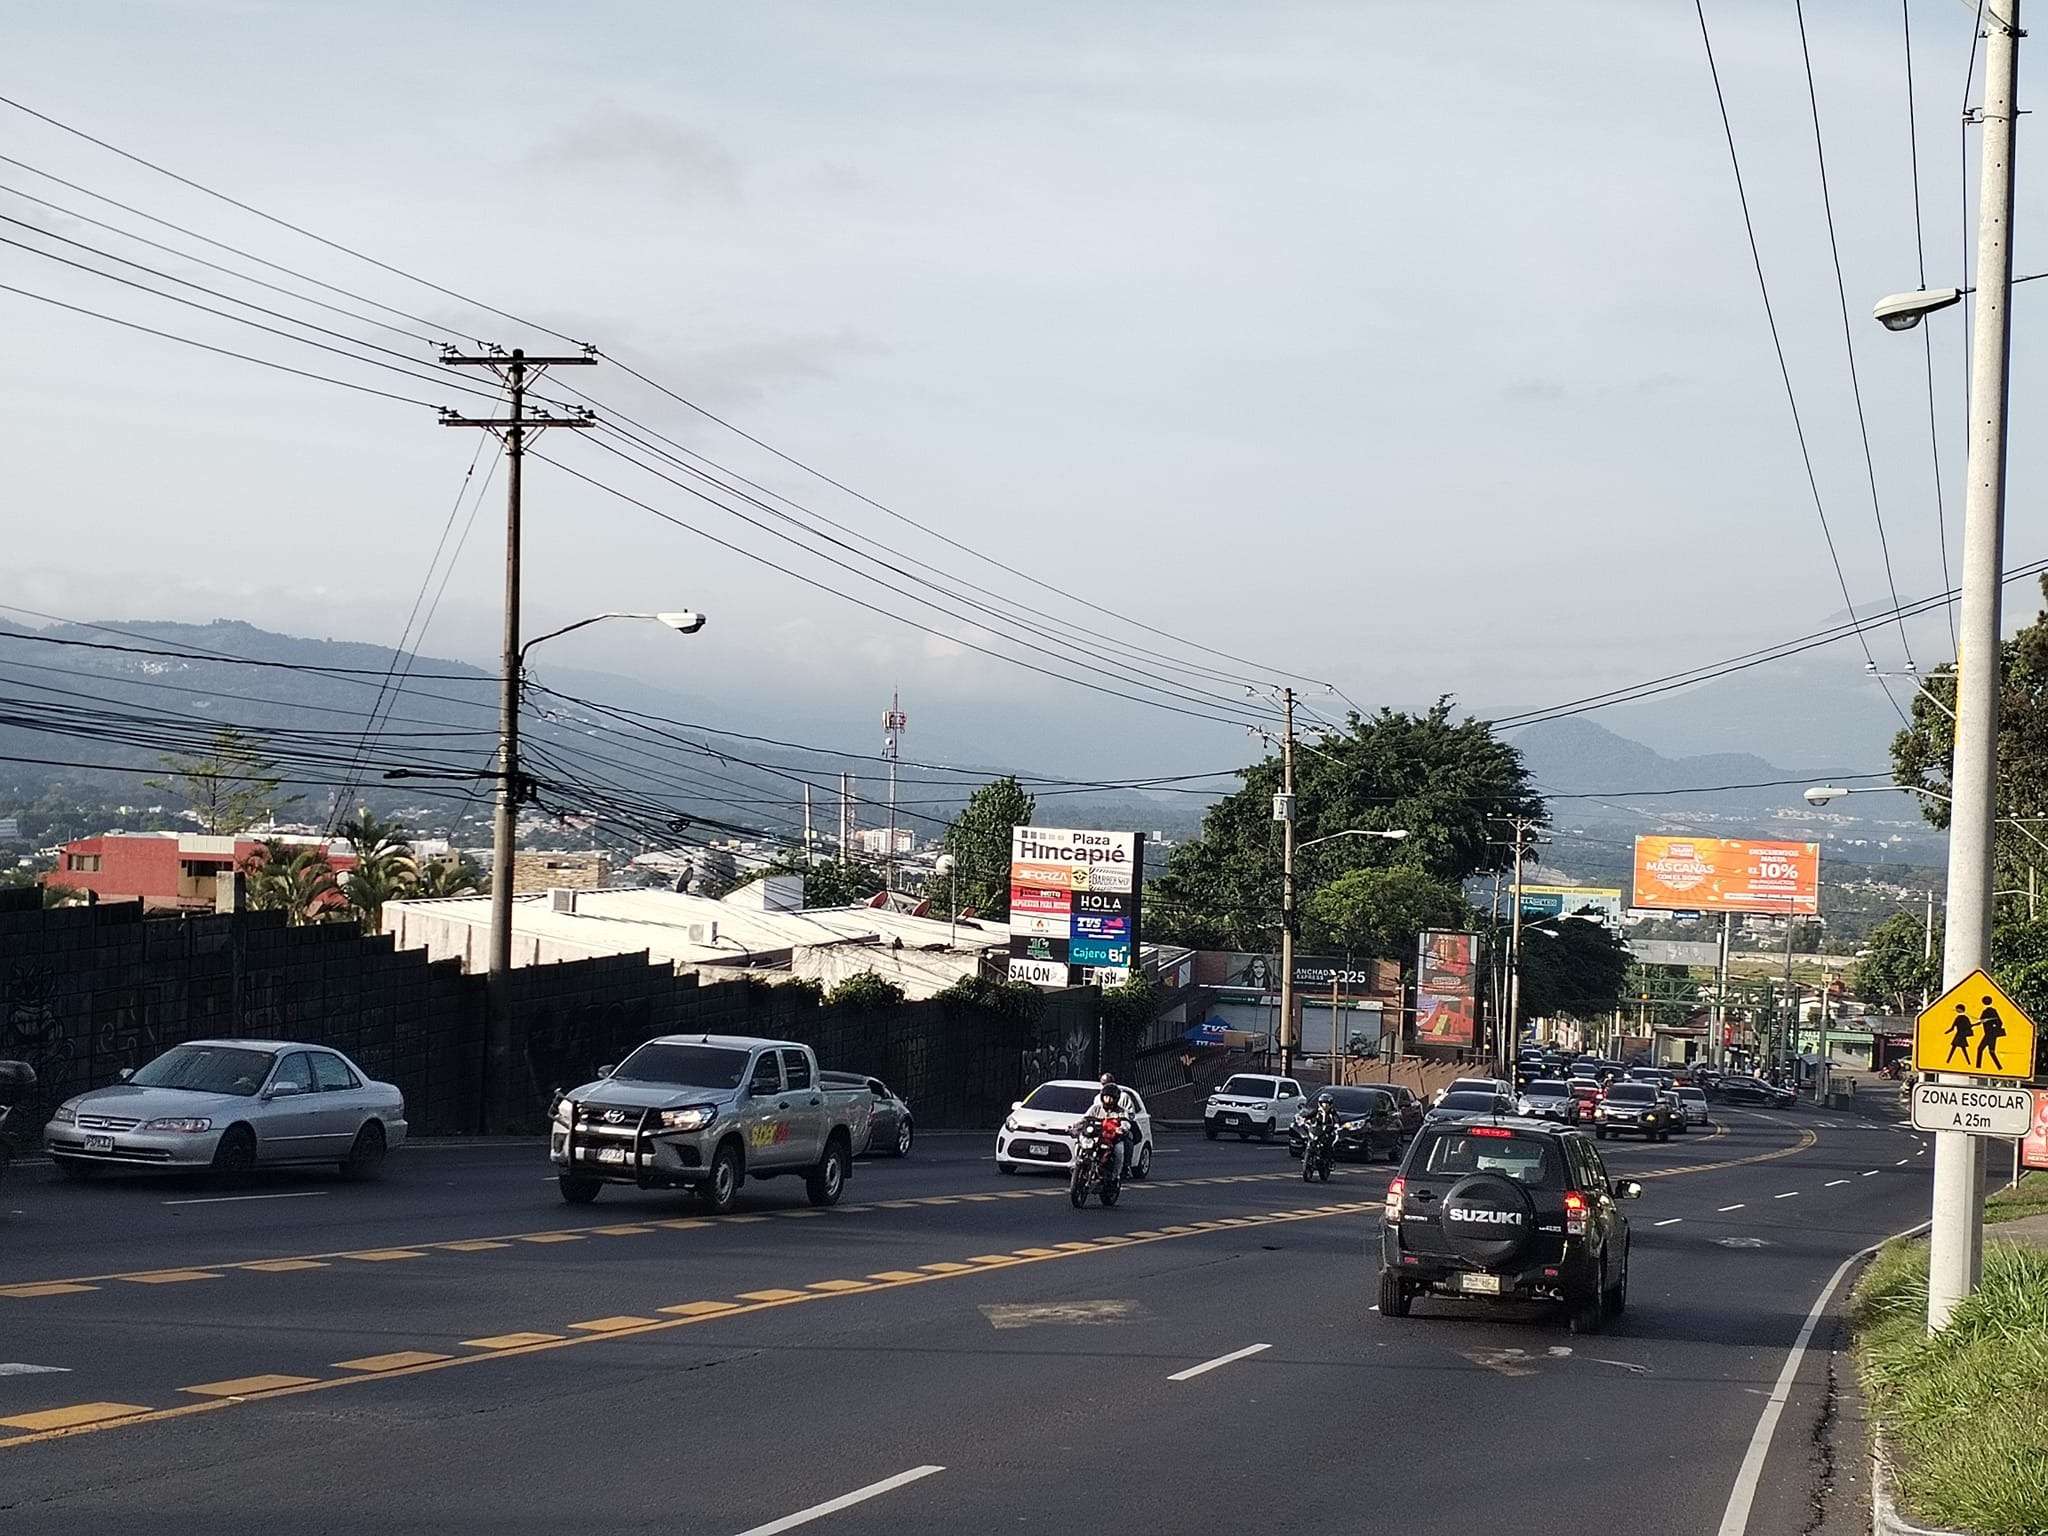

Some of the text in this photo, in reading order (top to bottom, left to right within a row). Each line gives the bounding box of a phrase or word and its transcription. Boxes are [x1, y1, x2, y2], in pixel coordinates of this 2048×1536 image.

[1073, 832, 1110, 846] Plaza
[1021, 843, 1125, 866] Hincapié
[1759, 863, 1799, 879] 10%
[1080, 895, 1122, 910] HOLA
[1077, 916, 1102, 928] TVS
[1073, 947, 1107, 960] Cajero
[1201, 1023, 1229, 1033] TVS
[1921, 1090, 1958, 1106] ZONA
[1961, 1092, 2025, 1110] ESCOLAR
[1952, 1112, 1991, 1128] A 25m
[1449, 1207, 1523, 1226] SUZUKI
